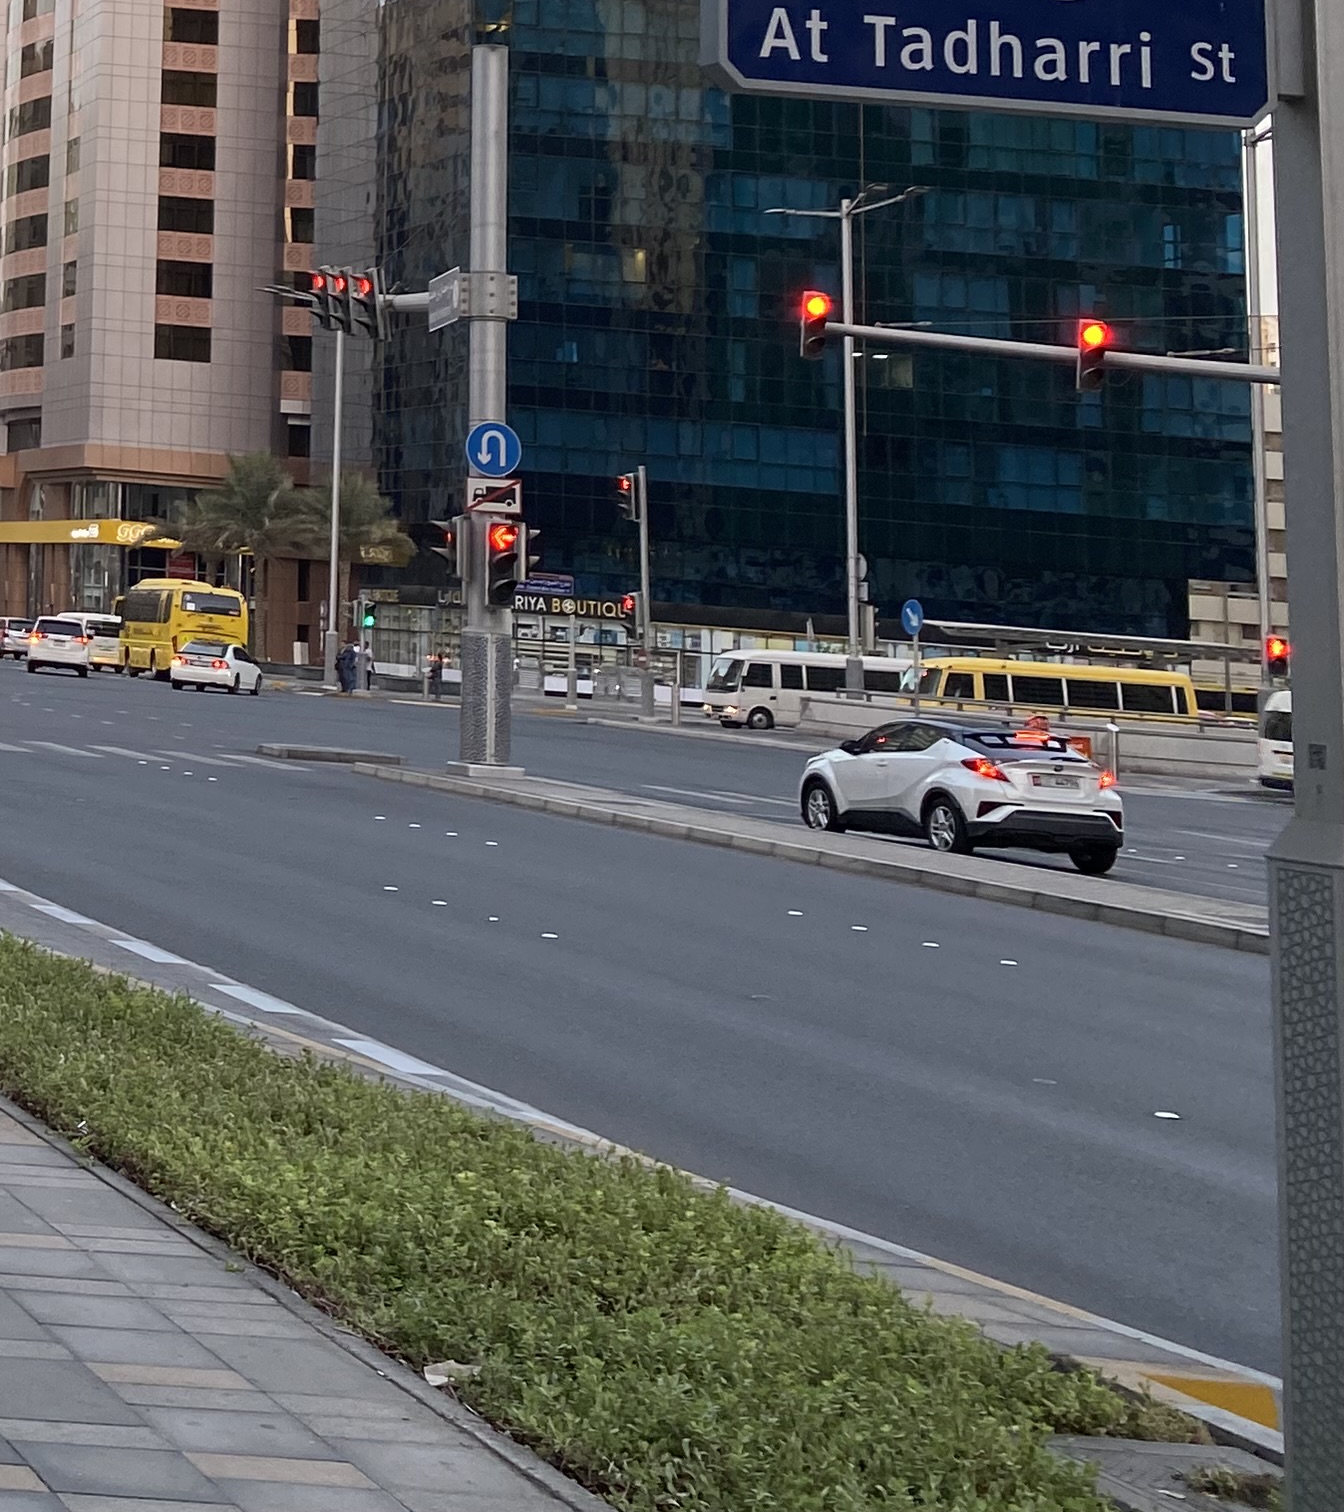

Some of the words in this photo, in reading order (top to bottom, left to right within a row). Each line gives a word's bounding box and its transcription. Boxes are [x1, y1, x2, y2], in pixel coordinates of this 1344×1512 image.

[758, 6, 830, 64] At
[862, 13, 1153, 89] Tadharri
[1190, 40, 1237, 85] St
[511, 594, 547, 612] RIYA
